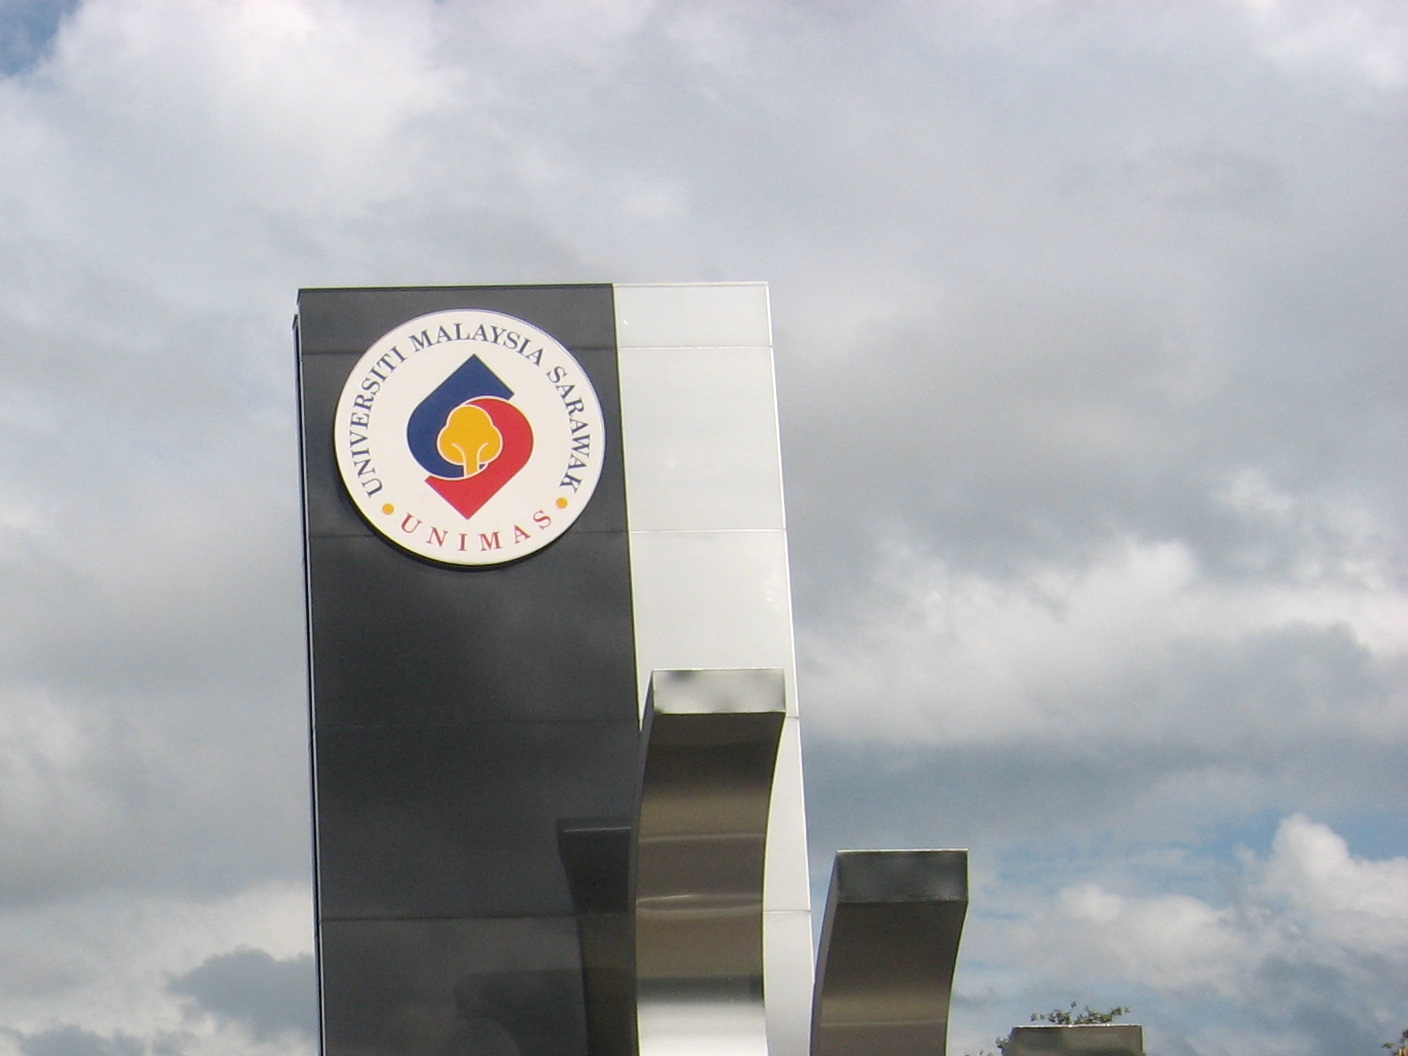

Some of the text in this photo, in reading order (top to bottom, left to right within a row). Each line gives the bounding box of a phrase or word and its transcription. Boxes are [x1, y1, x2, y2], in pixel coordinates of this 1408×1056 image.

[349, 322, 591, 498] UNIVERSITI MALAYSIA SARAWAK
[401, 509, 552, 551] UNIMAS
